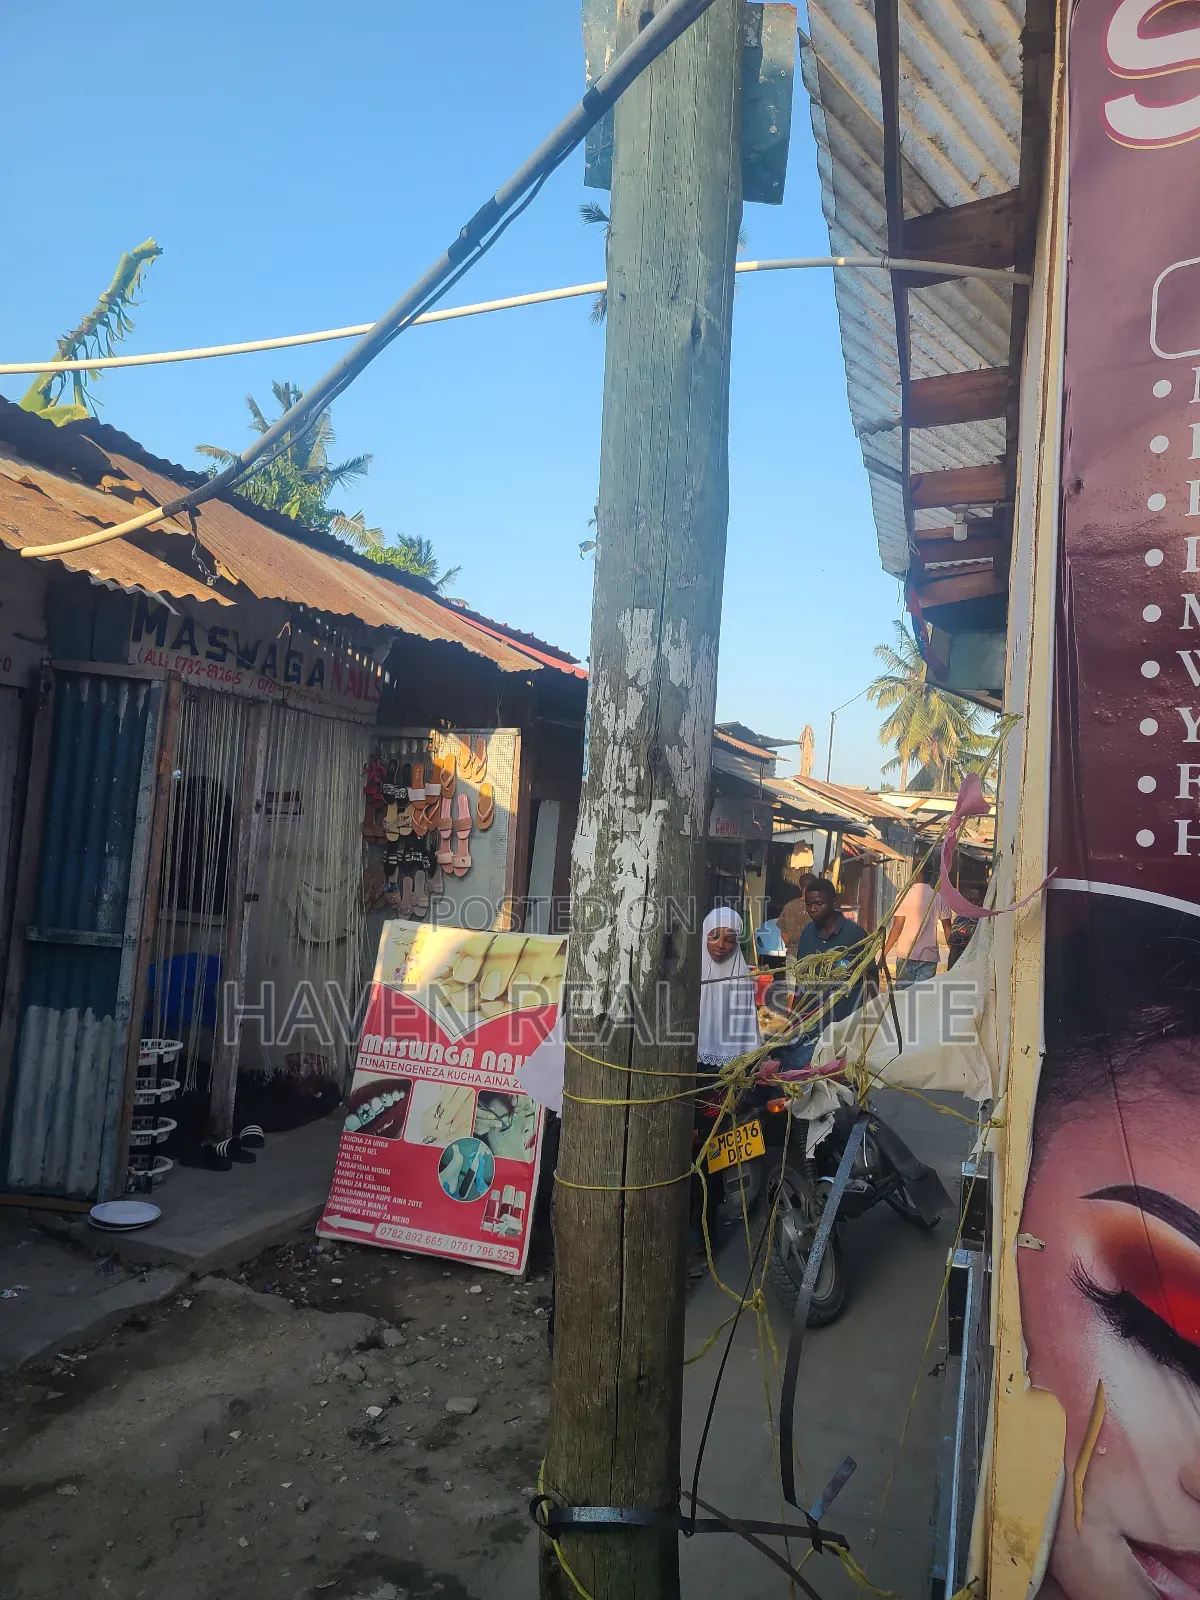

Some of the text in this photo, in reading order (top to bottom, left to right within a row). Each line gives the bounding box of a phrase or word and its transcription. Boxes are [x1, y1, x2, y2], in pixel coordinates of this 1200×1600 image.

[131, 595, 324, 690] MASWAGA
[361, 1033, 475, 1068] MASWAGA
[359, 1056, 445, 1078] TUNATENGENEZA
[447, 1070, 482, 1085] KUCHA
[483, 1075, 510, 1087] AINA
[344, 1135, 363, 1144] KUCHA
[364, 1137, 372, 1145] ZA
[354, 1180, 362, 1188] ZA
[356, 1171, 364, 1179] ZA
[408, 1200, 423, 1208] ZOTE
[380, 1226, 403, 1239] 0782
[405, 1232, 422, 1243] 892
[425, 1236, 443, 1247] 665
[450, 1240, 473, 1253] 0761
[476, 1245, 494, 1257] 796
[496, 1249, 515, 1261] 529
